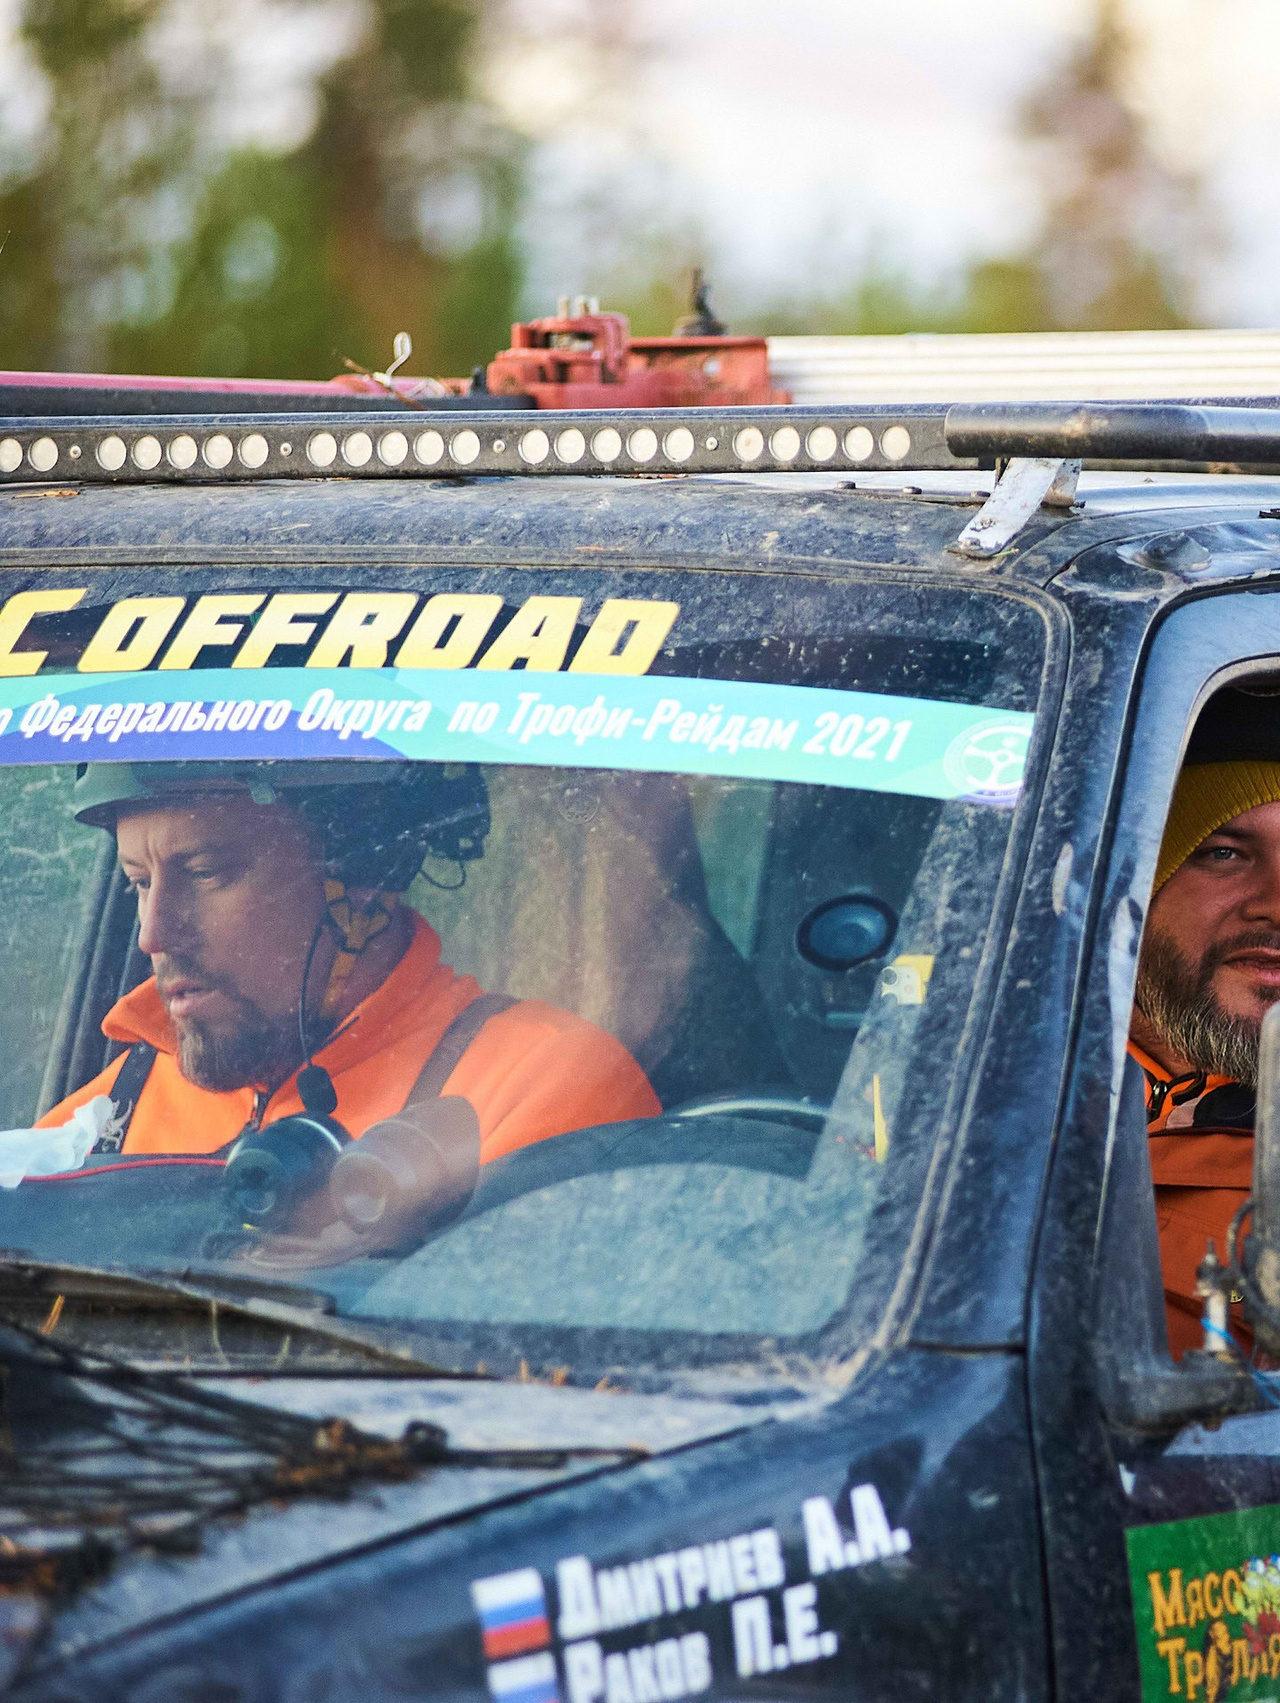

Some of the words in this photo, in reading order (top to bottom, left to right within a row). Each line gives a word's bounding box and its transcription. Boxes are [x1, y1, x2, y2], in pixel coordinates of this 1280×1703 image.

[77, 592, 681, 677] OFFROAD
[20, 692, 286, 744] Федерального
[299, 686, 429, 737] Округа
[449, 702, 499, 734] по
[507, 691, 800, 756] Трофи-Рейдам
[803, 711, 913, 763] 2021
[802, 1483, 912, 1575] А.А.
